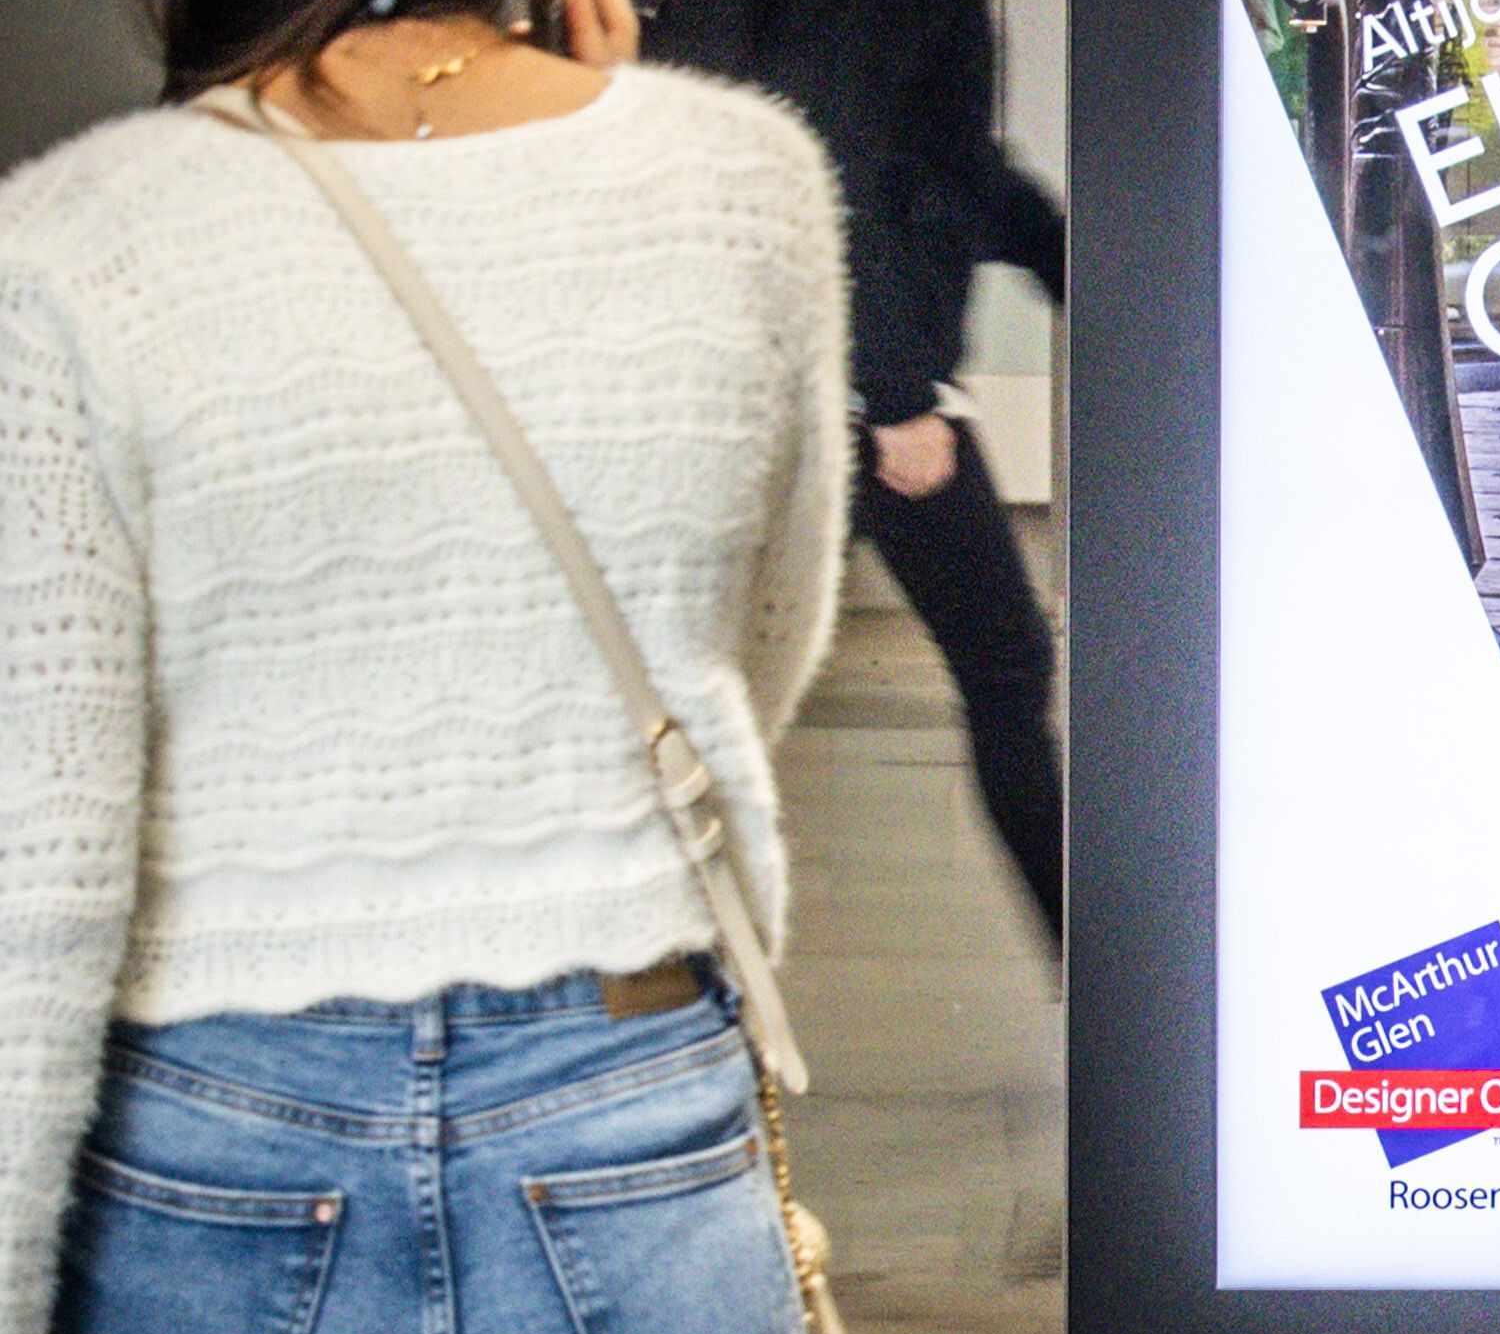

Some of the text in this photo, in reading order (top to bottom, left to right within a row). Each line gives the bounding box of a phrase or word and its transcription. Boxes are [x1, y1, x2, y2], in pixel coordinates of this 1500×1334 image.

[1334, 939, 1500, 1028] McArthur
[1350, 1011, 1436, 1063] Glen
[1313, 1078, 1474, 1122] Designer
